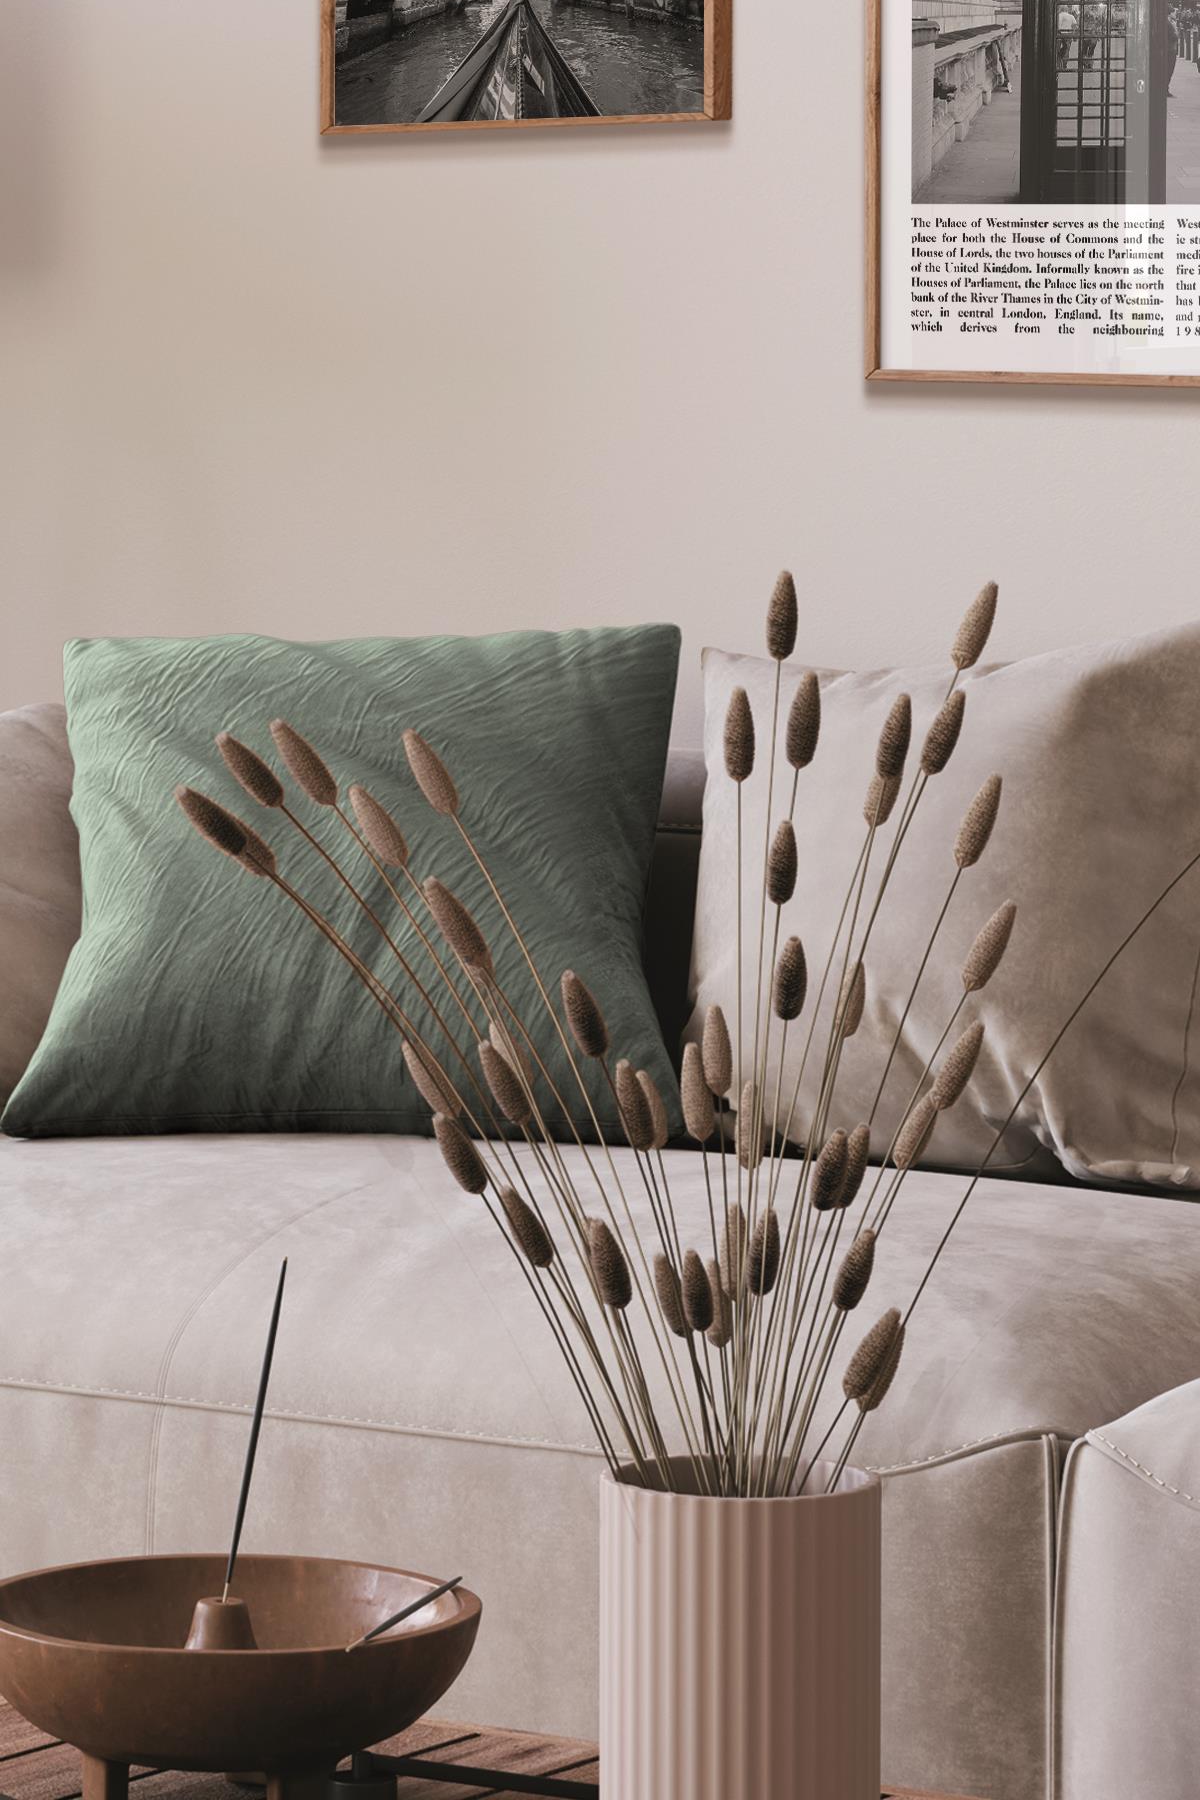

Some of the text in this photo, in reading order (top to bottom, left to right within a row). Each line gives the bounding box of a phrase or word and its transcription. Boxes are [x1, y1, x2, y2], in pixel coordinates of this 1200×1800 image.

[911, 217, 1165, 230] The Palace of Westminster serves as the meeting
[911, 232, 1165, 245] place for both the House of Commons and the
[1176, 233, 1186, 245] ic
[911, 247, 944, 258] House
[946, 247, 957, 258] of
[995, 247, 1012, 259] the
[1014, 250, 1035, 259] two
[1037, 248, 1072, 259] houses
[1074, 248, 1086, 259] of
[1088, 248, 1105, 260] the
[1108, 248, 1164, 260] Parliament
[910, 262, 922, 273] of
[925, 262, 941, 273] the
[945, 262, 979, 274] United
[1036, 263, 1090, 275] Informally
[1094, 263, 1130, 275] known
[1133, 267, 1144, 275] as
[1148, 264, 1164, 275] the
[1176, 264, 1195, 276] fire
[911, 276, 948, 288] Houses
[950, 277, 962, 288] of
[1024, 277, 1041, 289] the
[1044, 278, 1077, 290] Palace
[1080, 278, 1097, 290] lies
[1099, 282, 1113, 290] on
[1115, 279, 1133, 290] the
[1135, 279, 1164, 290] north
[1176, 280, 1196, 291] that
[911, 291, 1164, 306] bank of the River Thames in the City of Westmin-
[1176, 295, 1193, 307] has
[940, 306, 950, 318] in
[958, 307, 994, 319] central
[1109, 309, 1124, 321] Its
[1175, 311, 1193, 322] and
[911, 320, 1164, 337] which derives from the neighbouring
